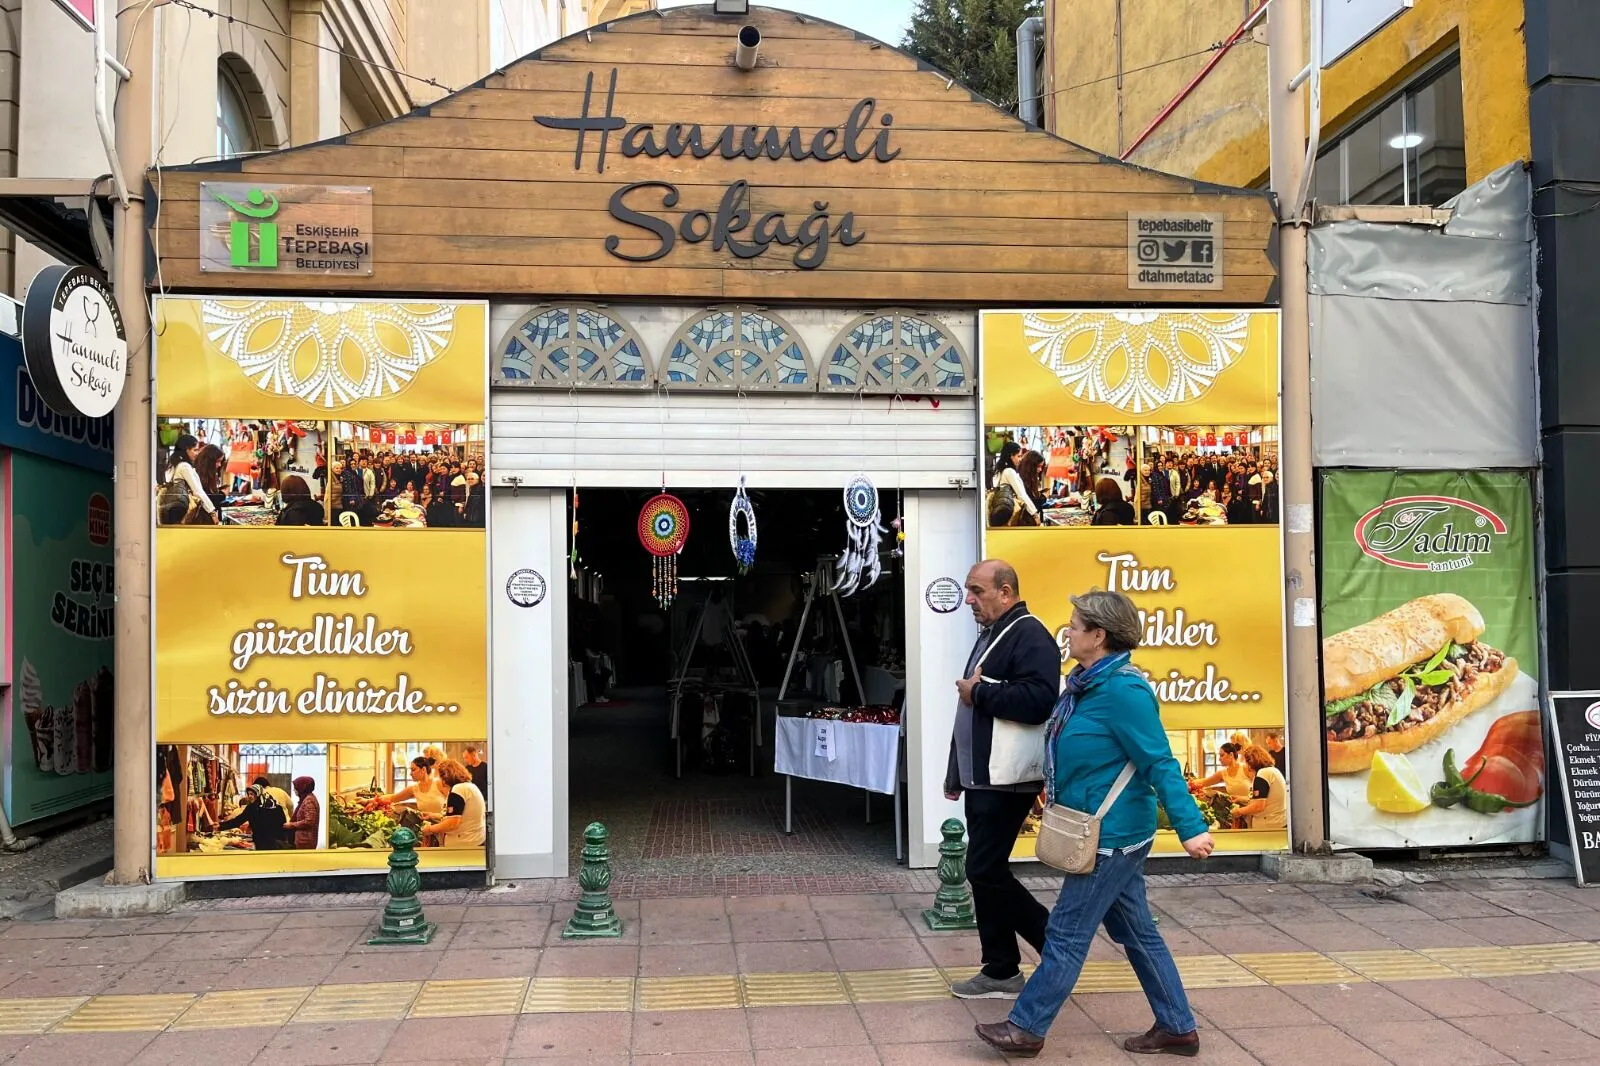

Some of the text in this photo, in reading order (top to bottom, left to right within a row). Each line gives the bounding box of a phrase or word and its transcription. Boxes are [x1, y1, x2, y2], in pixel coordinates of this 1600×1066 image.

[533, 68, 901, 173] Hanımeli
[604, 179, 866, 269] Sokağı
[1138, 218, 1213, 233] tepebasibeltr
[281, 236, 369, 258] TEPEBAŞI
[58, 274, 88, 305] TEPEBAŞI
[1138, 270, 1214, 284] dtahmetatac
[282, 554, 366, 598] Tüm
[1098, 552, 1175, 592] Tüm
[1430, 554, 1473, 571] tantuni
[232, 615, 412, 671] güzellikler
[209, 674, 458, 715] sizin elinizde...
[1569, 755, 1597, 764] Ekmek
[1570, 766, 1599, 775] Ekmek
